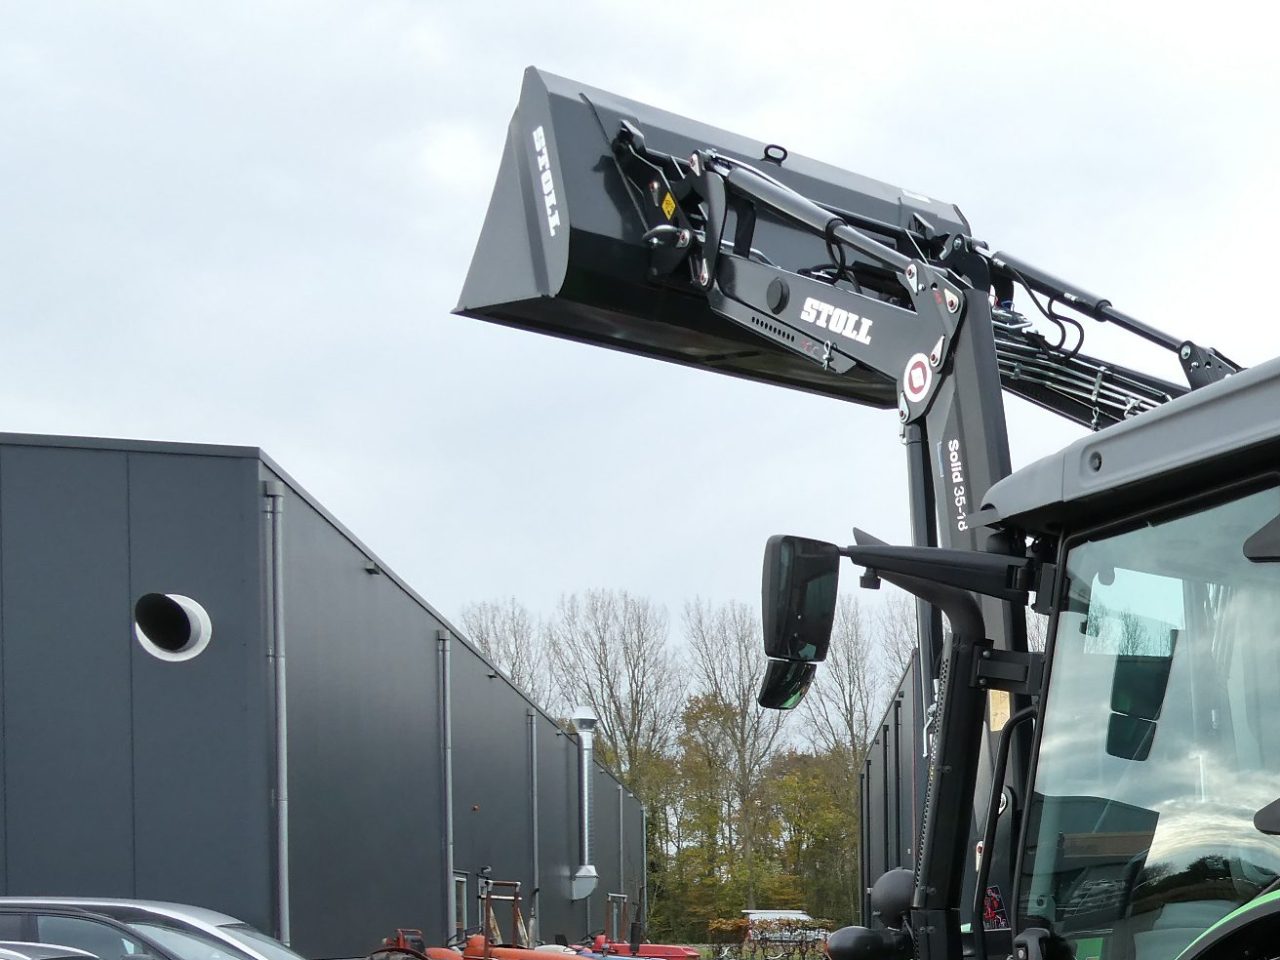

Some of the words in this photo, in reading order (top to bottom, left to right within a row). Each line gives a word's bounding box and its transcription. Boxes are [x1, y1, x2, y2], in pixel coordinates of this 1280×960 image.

[532, 125, 561, 237] STOLL
[800, 297, 873, 345] STOLL
[948, 439, 964, 484] Solid
